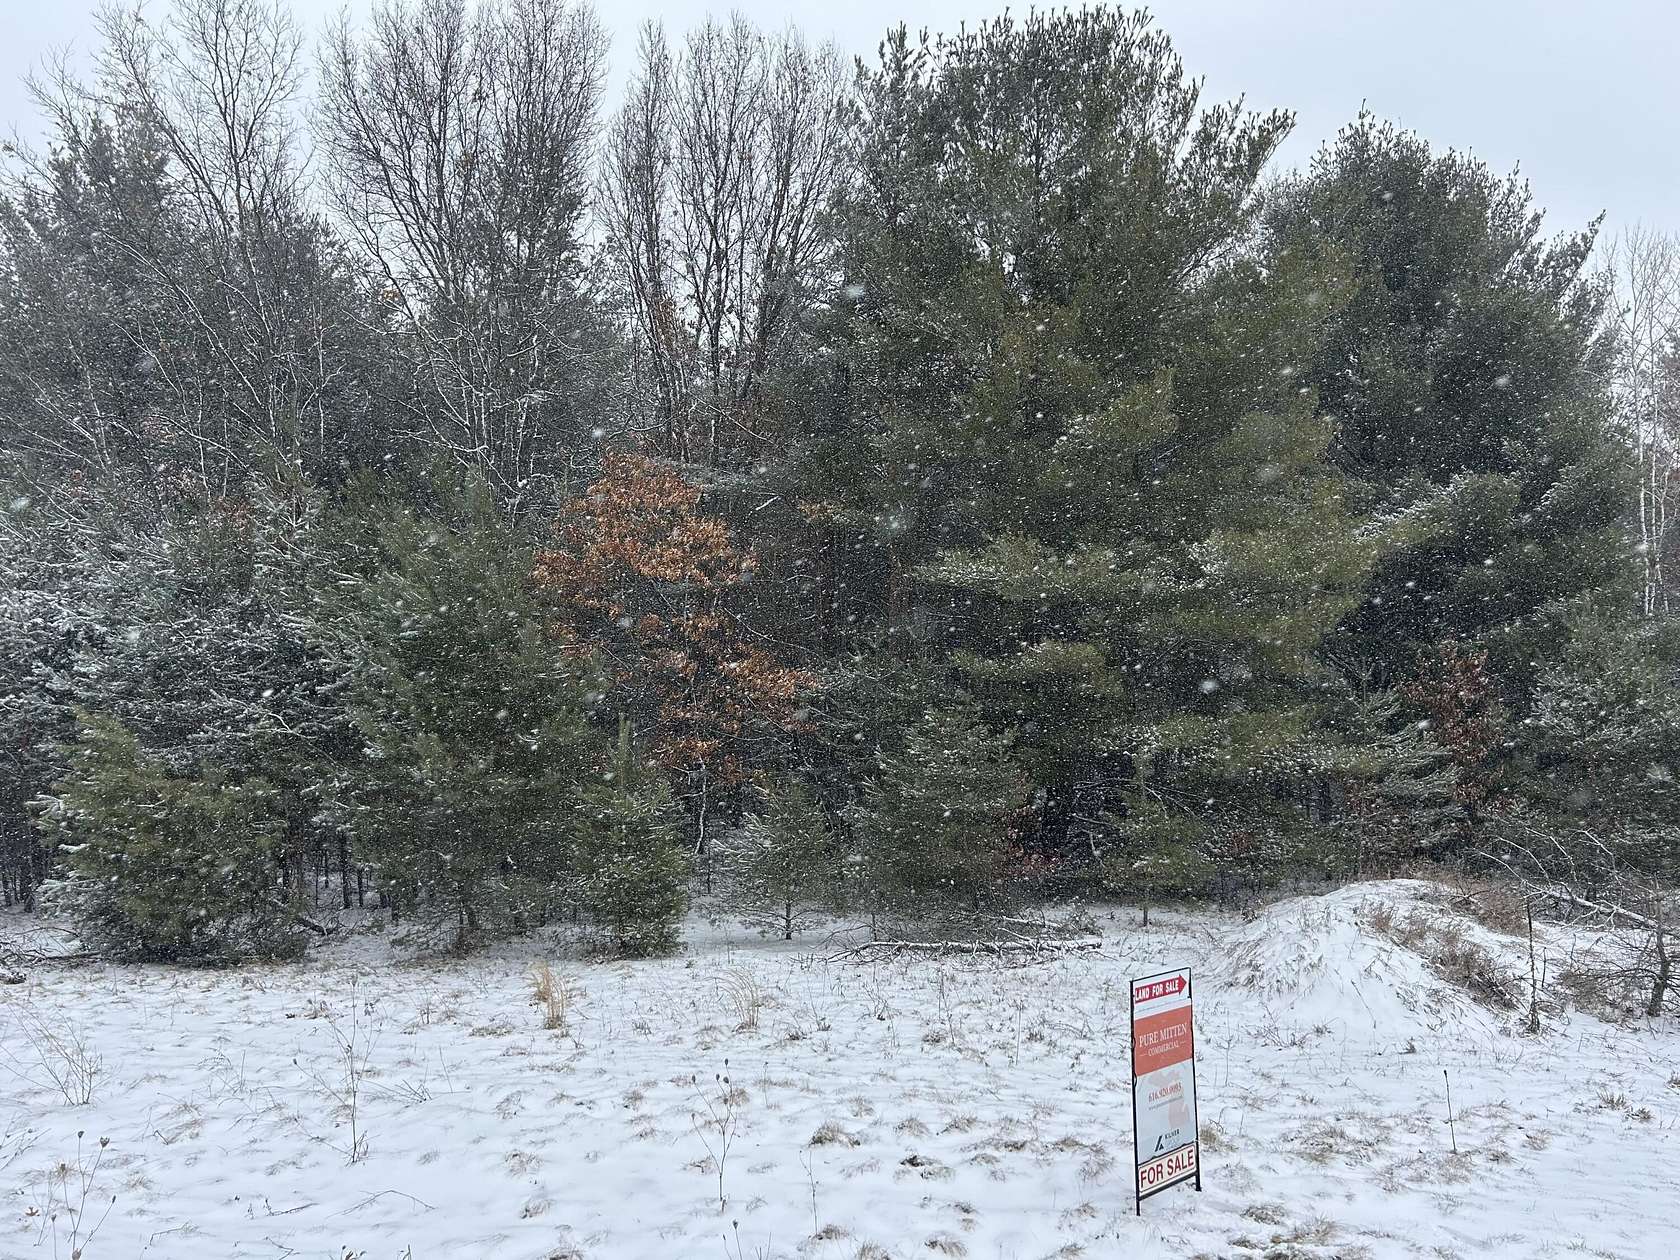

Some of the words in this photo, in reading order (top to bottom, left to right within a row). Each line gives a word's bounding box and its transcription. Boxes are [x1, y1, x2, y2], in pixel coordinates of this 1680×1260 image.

[1135, 988, 1150, 1001] LAND
[1152, 984, 1164, 997] FOR
[1165, 980, 1179, 994] SALE
[1139, 1031, 1159, 1048] PURE
[1160, 1022, 1187, 1041] MITTEN
[1148, 1040, 1179, 1057] COMMERCIAL
[1140, 1162, 1164, 1188] FOR
[1167, 1149, 1194, 1176] SALE
